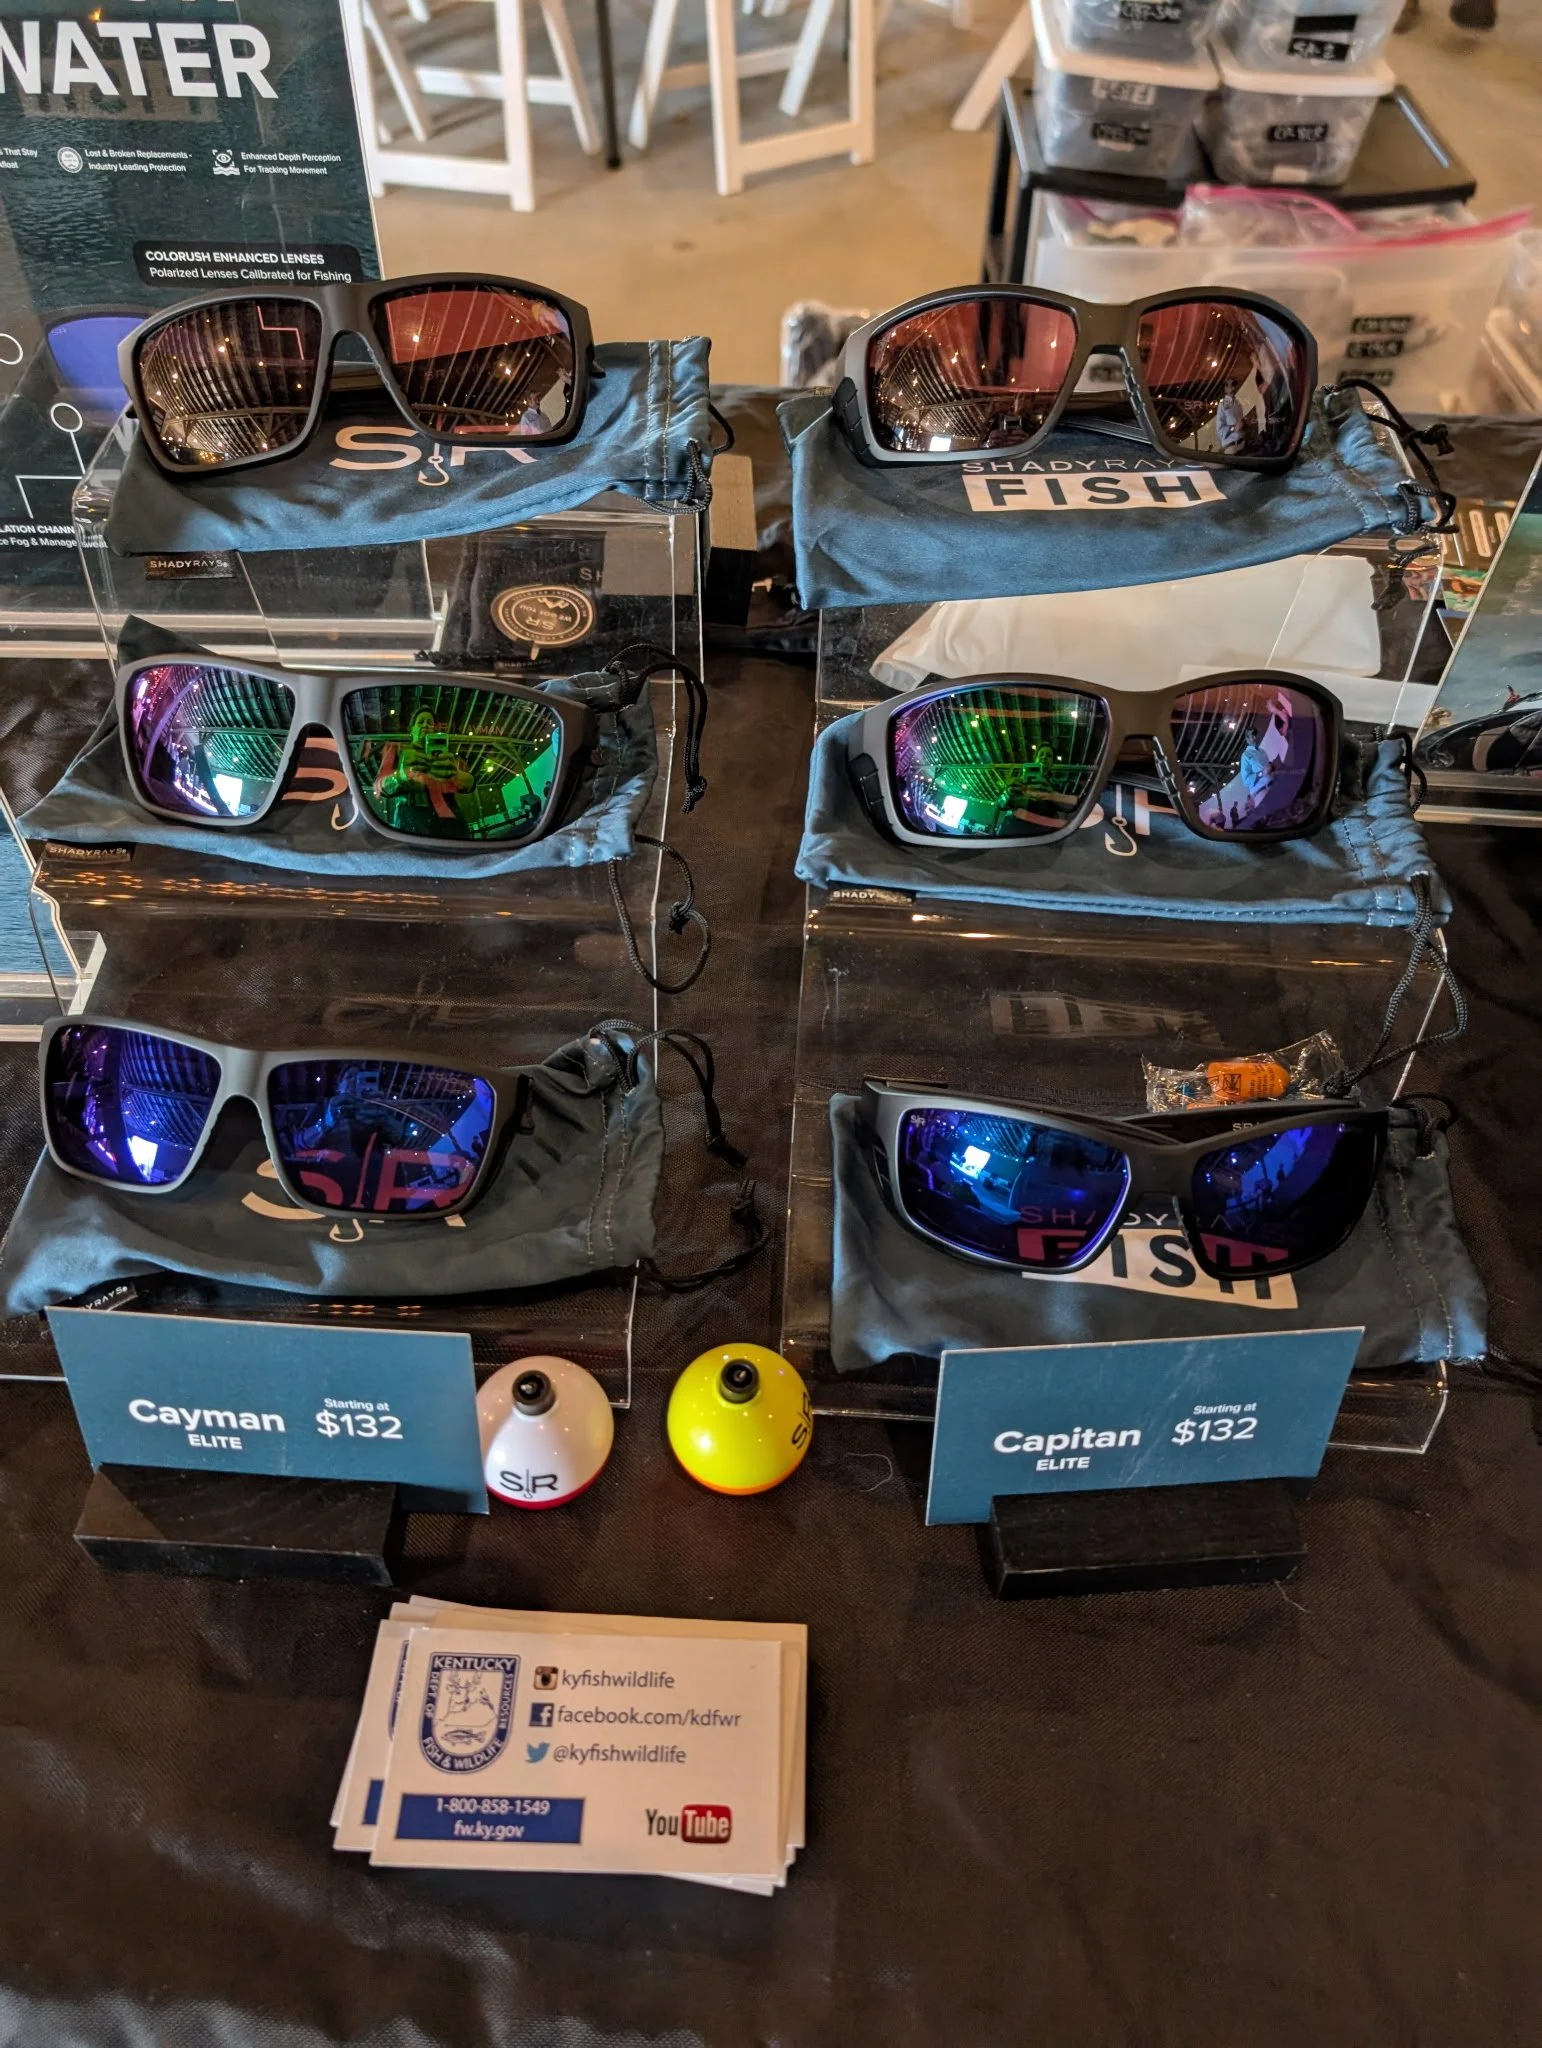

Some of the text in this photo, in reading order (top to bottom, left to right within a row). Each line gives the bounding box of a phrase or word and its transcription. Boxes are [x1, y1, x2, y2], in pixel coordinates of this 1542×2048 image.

[3, 147, 21, 156] That
[21, 148, 38, 158] Stay
[85, 149, 101, 157] Lost
[110, 150, 136, 158] Broken
[137, 150, 188, 159] Replacements
[241, 152, 341, 162] Enhanced Depth Perception
[88, 162, 187, 172] Industry Leading Protection
[244, 165, 328, 175] For Tracking Movement
[145, 251, 325, 265] COLORUSH ENHANCED LENSES
[149, 267, 352, 284] Polarized Lenses Calibrated for Fishing
[962, 458, 1205, 473] SHADYRAY
[984, 475, 1204, 507] FISH
[10, 537, 30, 548] Fog
[31, 538, 39, 547] &
[40, 538, 78, 549] Manage
[150, 558, 224, 568] SHADYRAYS
[49, 846, 126, 856] SHADYRAYS
[324, 1397, 390, 1412] Starting at
[1193, 1401, 1258, 1415] Starting at
[128, 1398, 404, 1440] Cayman $132
[188, 1433, 243, 1450] ELITE
[993, 1416, 1259, 1456] Capitan $132
[1035, 1456, 1091, 1472] ELITE
[433, 1656, 515, 1670] KENTUCKY
[561, 1669, 675, 1690] kyfishwildlife
[499, 1672, 514, 1729] RESOURCES
[424, 1703, 434, 1718] OF
[557, 1705, 742, 1727] facebook.com/kdfwr
[423, 1736, 503, 1769] FISH & WILDLIFE
[553, 1743, 687, 1765] @kyfishwildlife
[436, 1797, 550, 1815] 1-800-858-1549
[453, 1820, 525, 1840] fw.ky.gov
